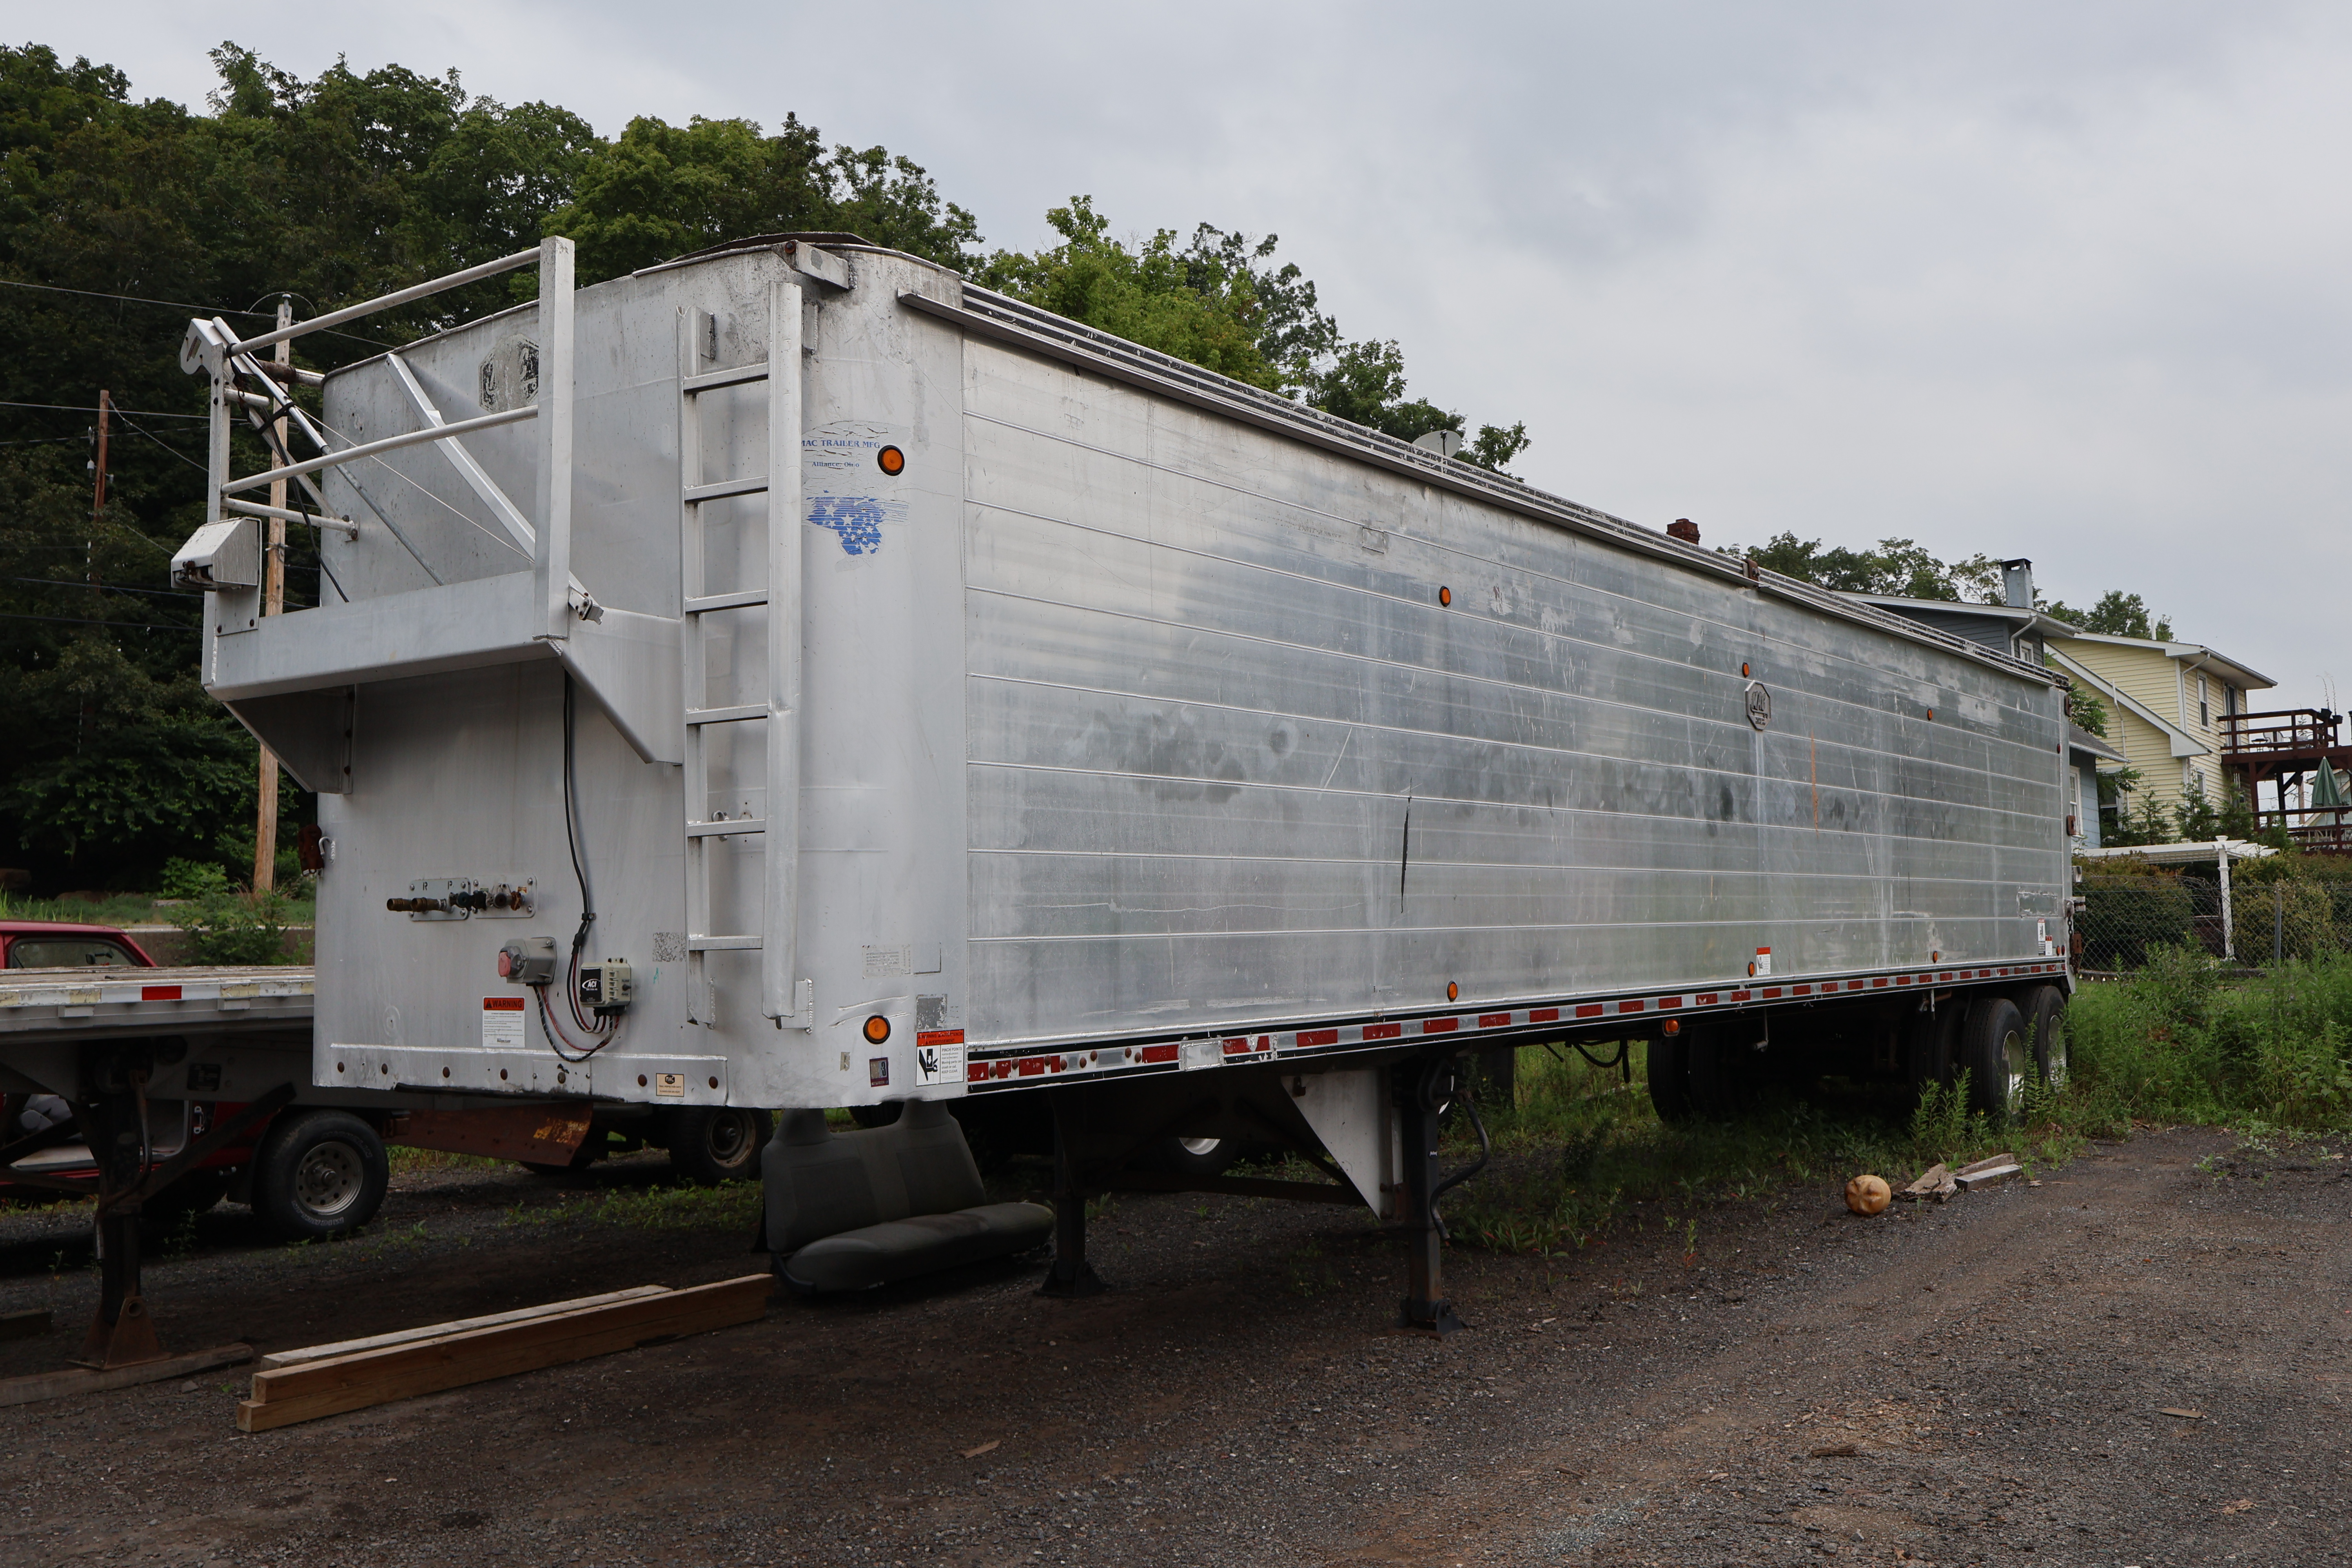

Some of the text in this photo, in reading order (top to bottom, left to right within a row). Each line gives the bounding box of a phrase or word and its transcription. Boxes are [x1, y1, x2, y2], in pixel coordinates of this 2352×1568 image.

[423, 881, 452, 891] R P
[492, 999, 522, 1008] WARNING
[291, 1200, 344, 1226] MICHELIN
